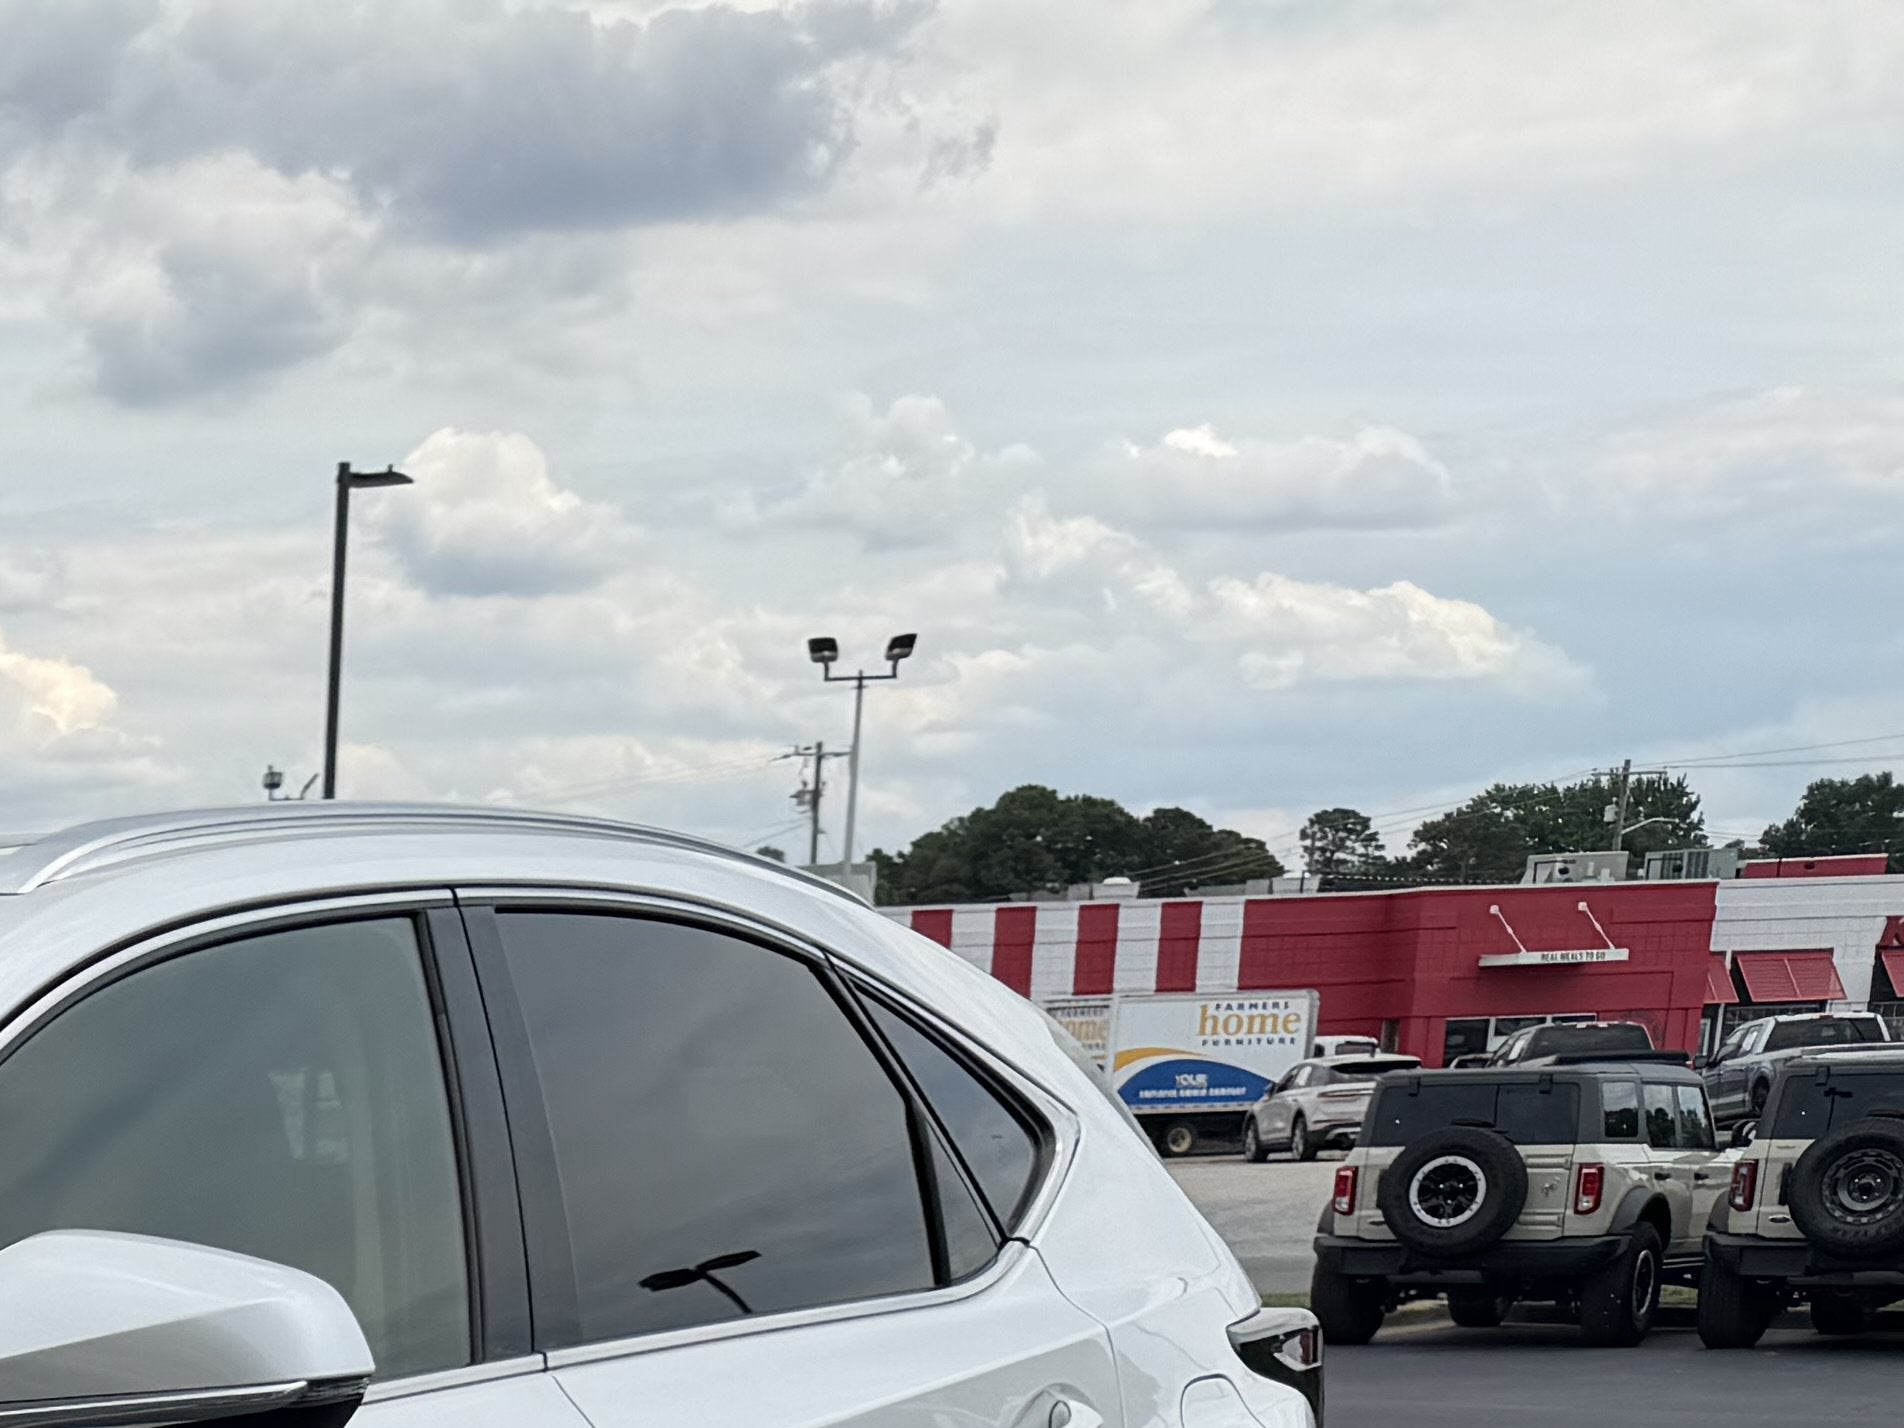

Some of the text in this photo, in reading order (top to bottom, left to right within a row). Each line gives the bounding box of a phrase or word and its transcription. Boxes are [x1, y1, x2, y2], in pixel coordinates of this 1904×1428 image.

[1215, 1001, 1291, 1012] FARMERS
[1196, 1004, 1301, 1037] home
[1201, 1036, 1296, 1047] FURNITURE
